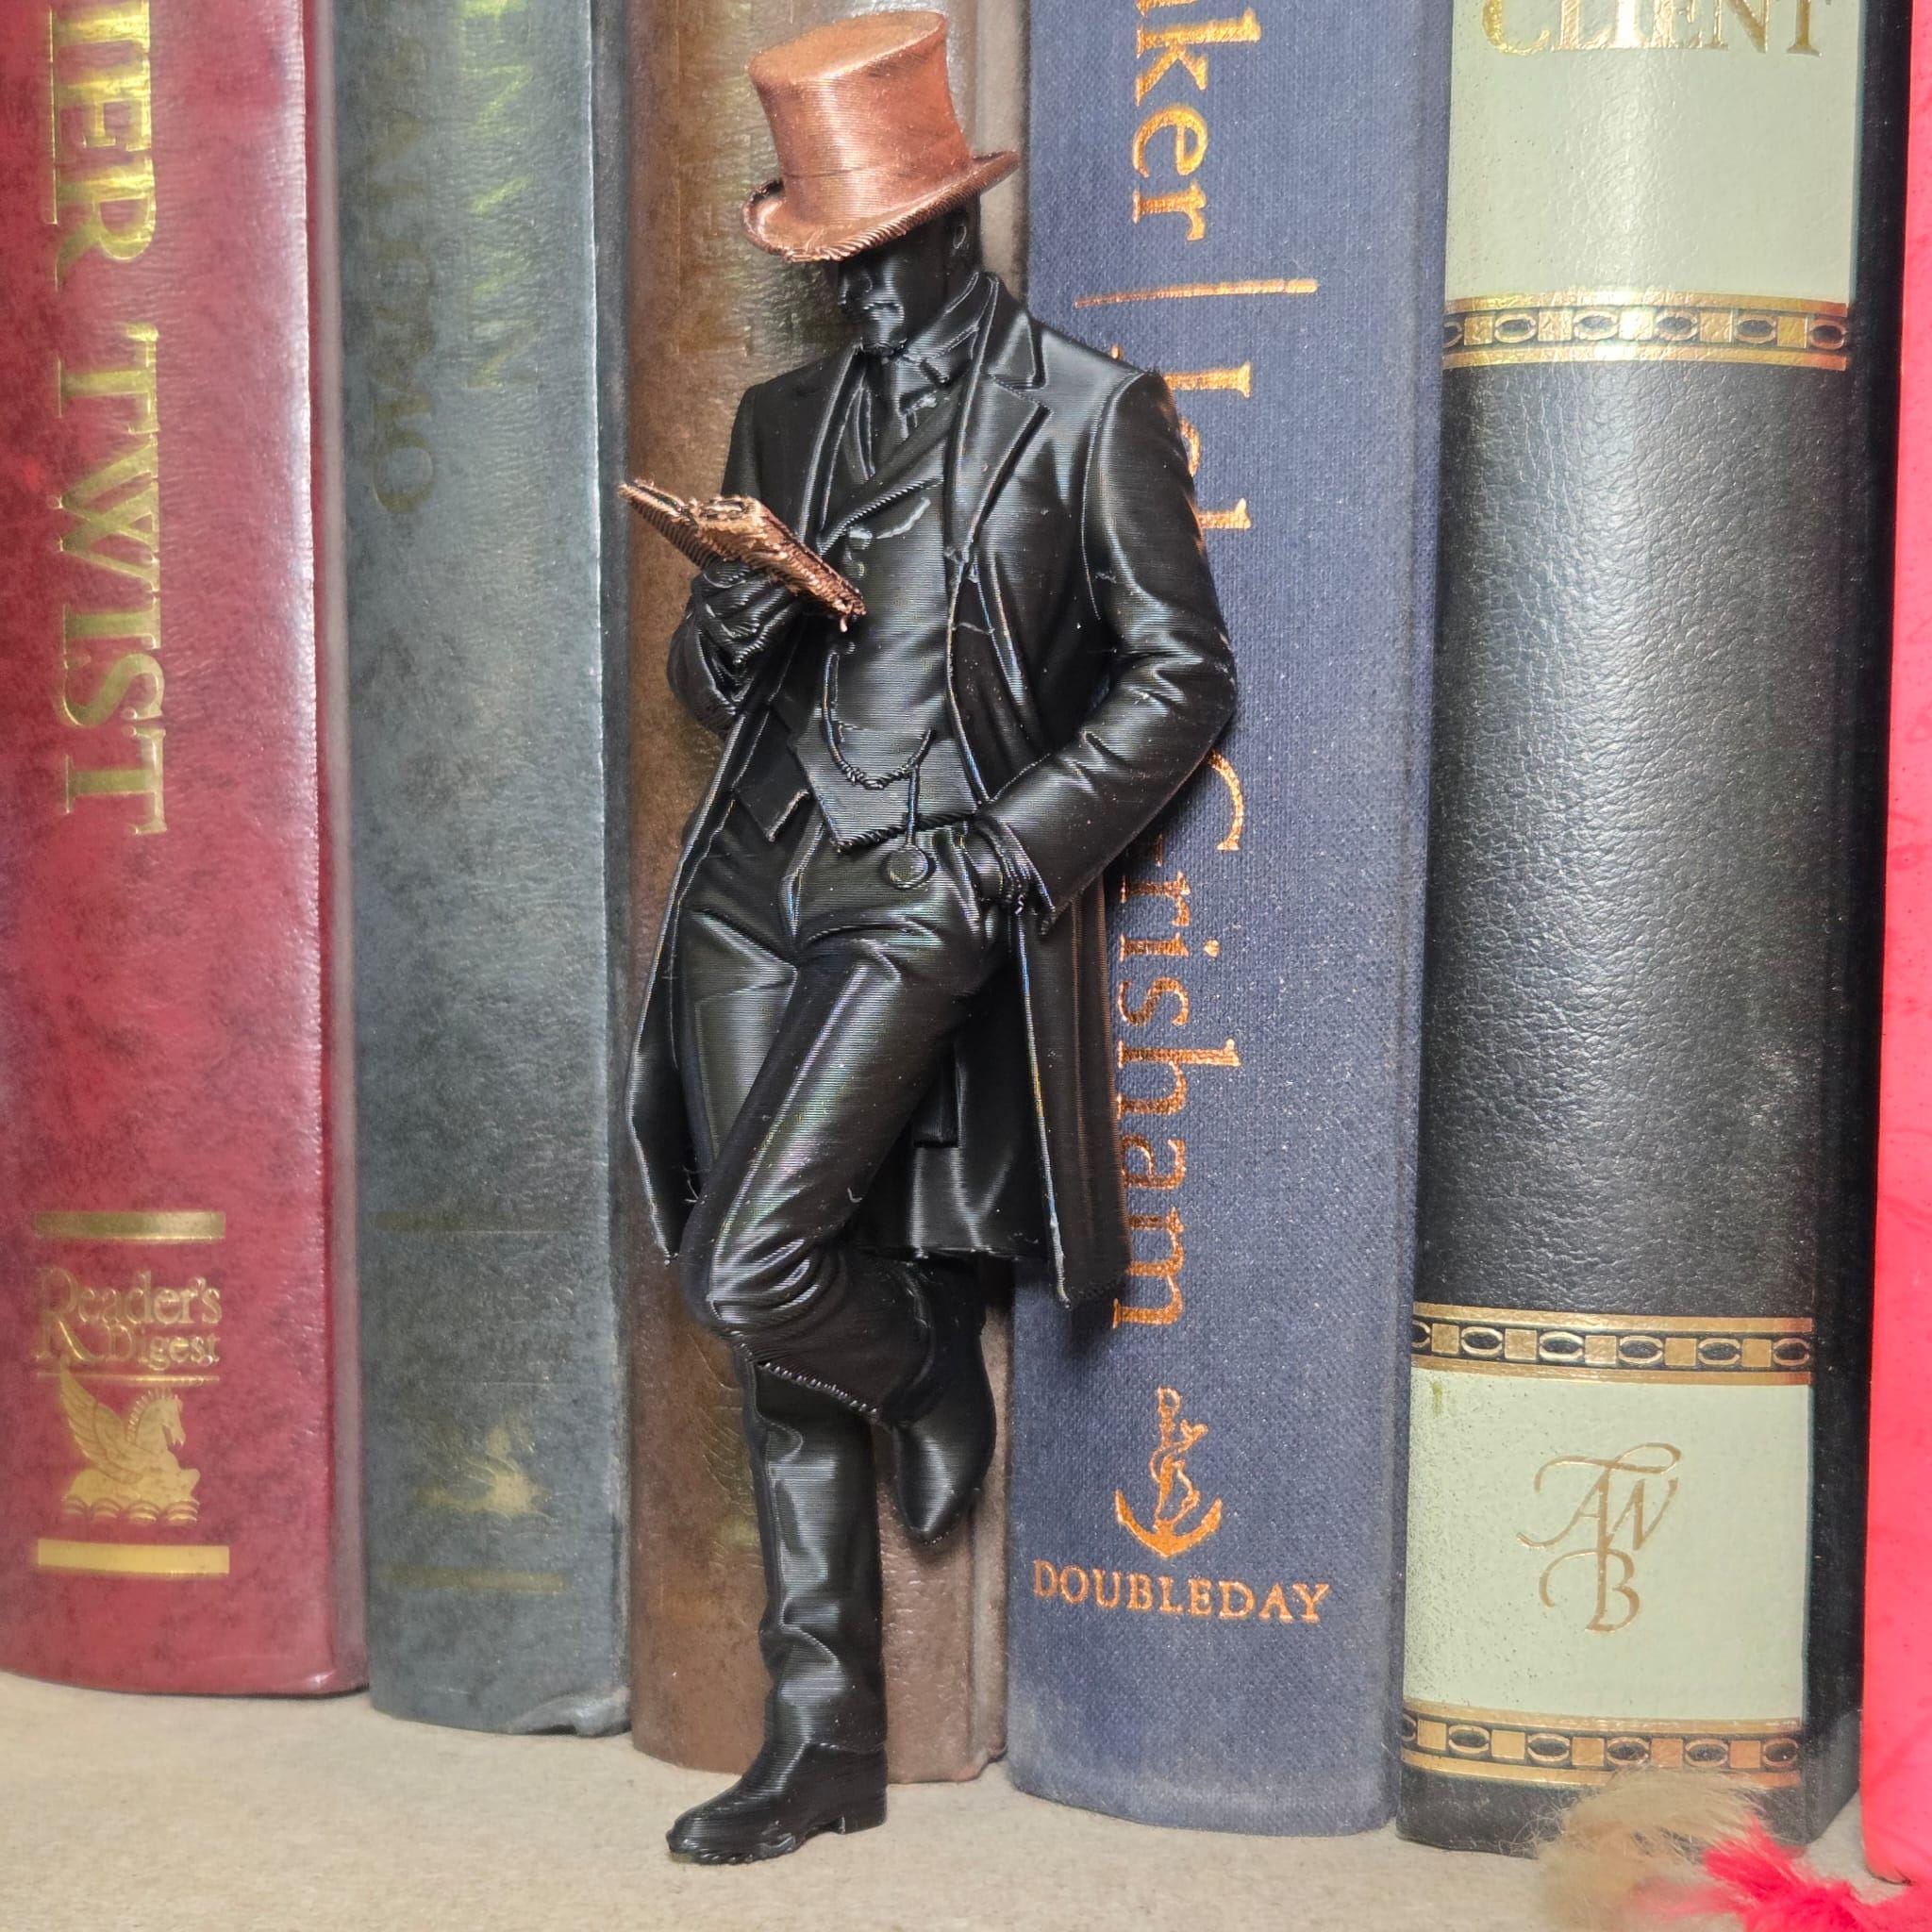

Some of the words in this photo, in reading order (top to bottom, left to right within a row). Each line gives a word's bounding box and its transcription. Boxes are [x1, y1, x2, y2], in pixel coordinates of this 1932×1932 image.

[1481, 0, 1823, 57] CLIENT
[48, 323, 168, 835] TWIST
[35, 1266, 223, 1361] Reader's
[103, 1323, 221, 1371] Digest
[1033, 1558, 1330, 1623] DOUBLEDAY
